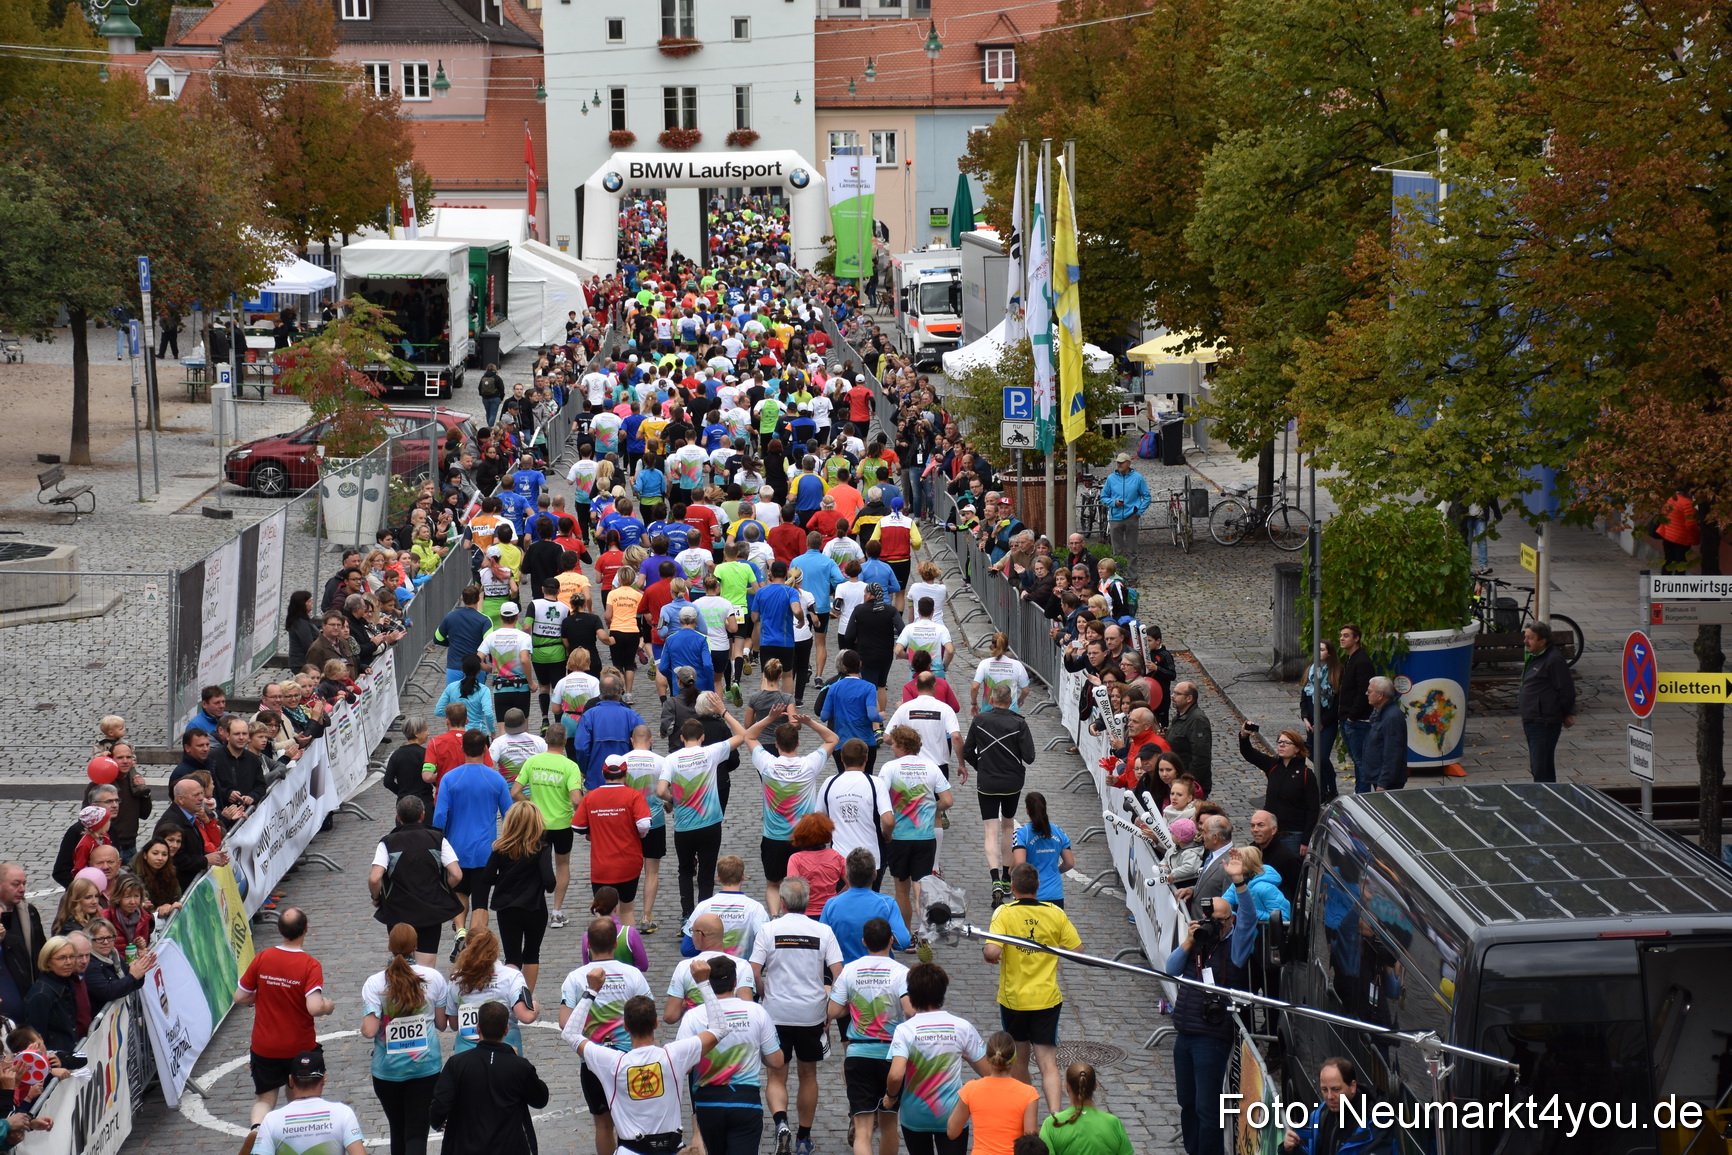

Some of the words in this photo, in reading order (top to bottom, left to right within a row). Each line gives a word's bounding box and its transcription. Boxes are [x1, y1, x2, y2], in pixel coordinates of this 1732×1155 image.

[630, 162, 682, 178] BMW
[689, 160, 782, 180] Laufsport
[730, 290, 740, 300] 15
[763, 292, 770, 300] 8
[222, 374, 228, 382] P
[1010, 391, 1026, 415] P
[1657, 680, 1721, 695] oiletten
[540, 772, 563, 784] DAV
[1153, 826, 1166, 842] BMW
[856, 978, 892, 986] NeuerMarkt
[391, 1024, 423, 1040] 2062
[282, 1122, 333, 1134] NeuerMarkt
